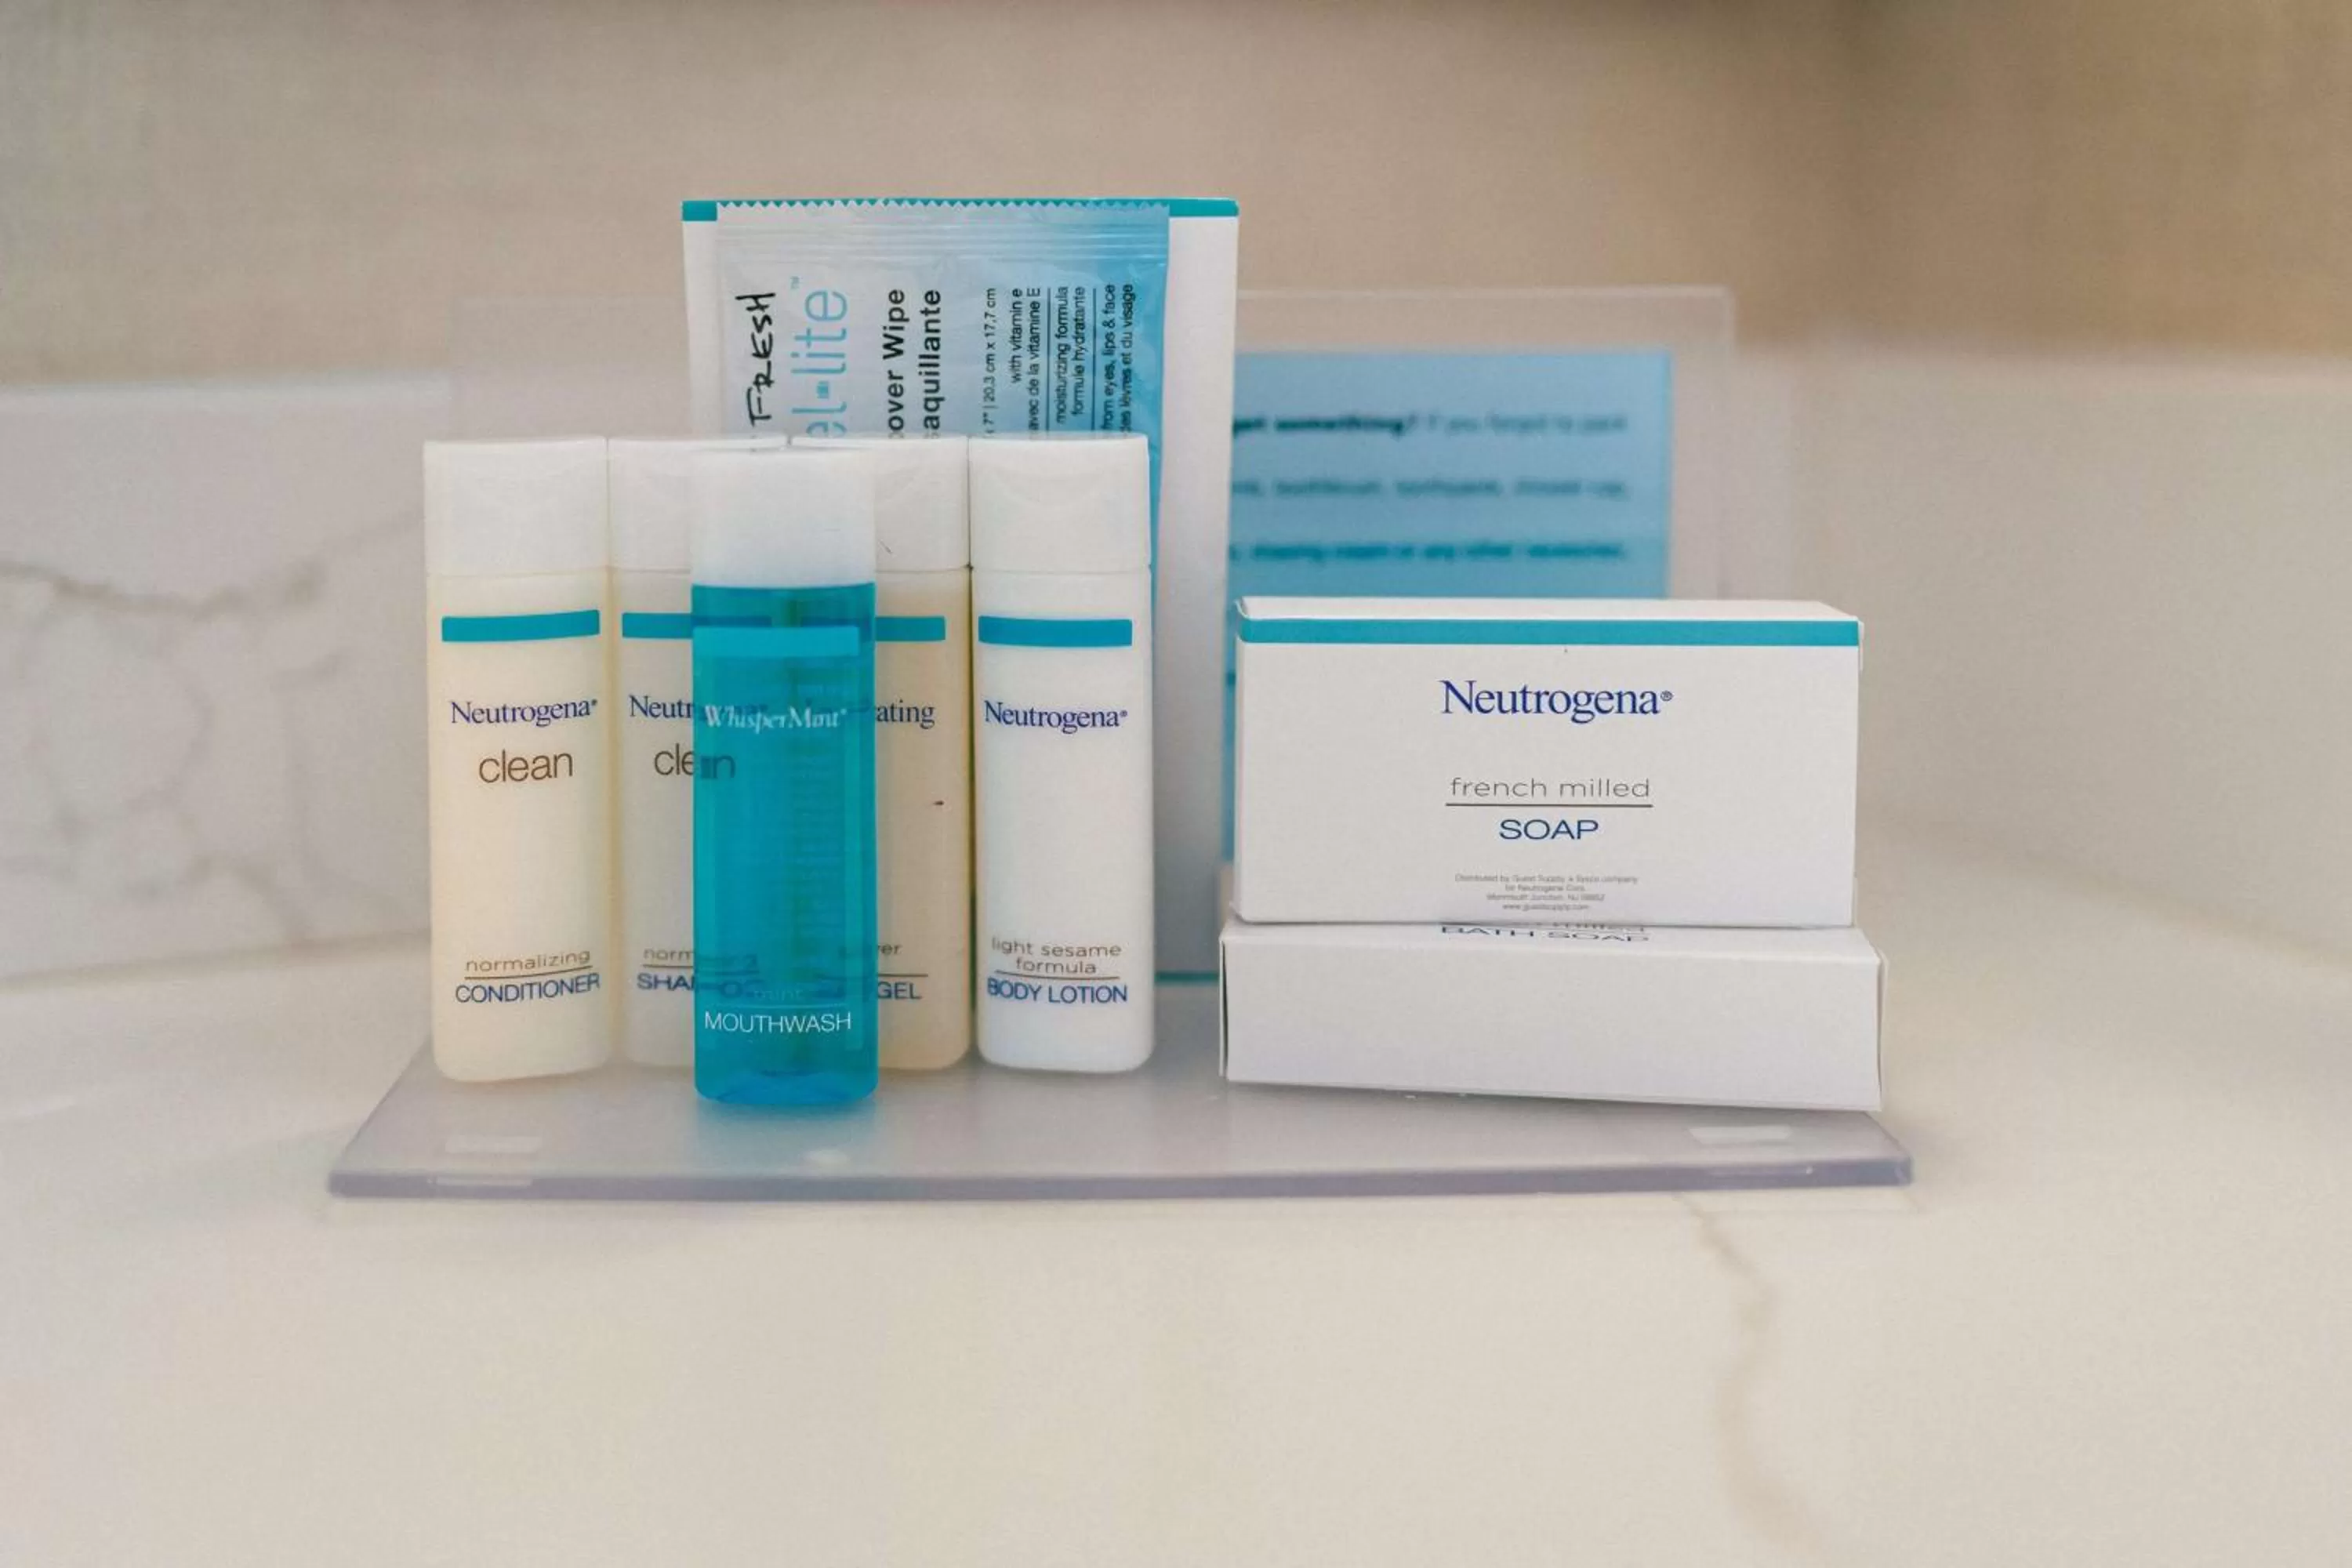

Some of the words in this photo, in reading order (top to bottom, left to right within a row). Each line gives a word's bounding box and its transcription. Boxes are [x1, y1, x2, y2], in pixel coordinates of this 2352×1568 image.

[986, 288, 996, 308] cm
[1012, 288, 1023, 297] e
[1027, 288, 1040, 297] E
[1102, 284, 1116, 314] face
[1055, 286, 1069, 339] formula
[1122, 284, 1135, 328] visage
[882, 289, 909, 360] Wipe
[1009, 301, 1022, 351] vitamin
[1027, 300, 1040, 360] vitamine
[1072, 286, 1087, 361] hydratante
[1102, 318, 1116, 328] &
[1102, 332, 1116, 356] lips
[1121, 332, 1133, 349] du
[735, 292, 776, 427] FRESH
[918, 289, 946, 437] aquillante
[986, 353, 996, 373] cm
[1008, 354, 1022, 383] with
[1026, 363, 1040, 376] la
[1121, 352, 1133, 365] et
[1026, 379, 1040, 396] de
[1055, 343, 1071, 424] moisturizing
[1070, 365, 1085, 416] formule
[887, 369, 905, 437] over
[479, 749, 573, 783] clean
[1450, 778, 1547, 797] french
[1560, 779, 1650, 797] milled
[1499, 819, 1599, 840] SOAP
[1442, 926, 1534, 937] BATH
[1548, 931, 1649, 942] SOAP
[992, 937, 1033, 955] light
[1041, 945, 1122, 956] sesame
[465, 949, 590, 973] normalizing
[1016, 956, 1097, 974] formula
[456, 972, 601, 1004] CONDITIONER
[877, 981, 922, 1000] GEL
[987, 977, 1042, 1001] BODY
[1048, 985, 1127, 1004] LOTION
[705, 1011, 851, 1033] MOUTHWASH
